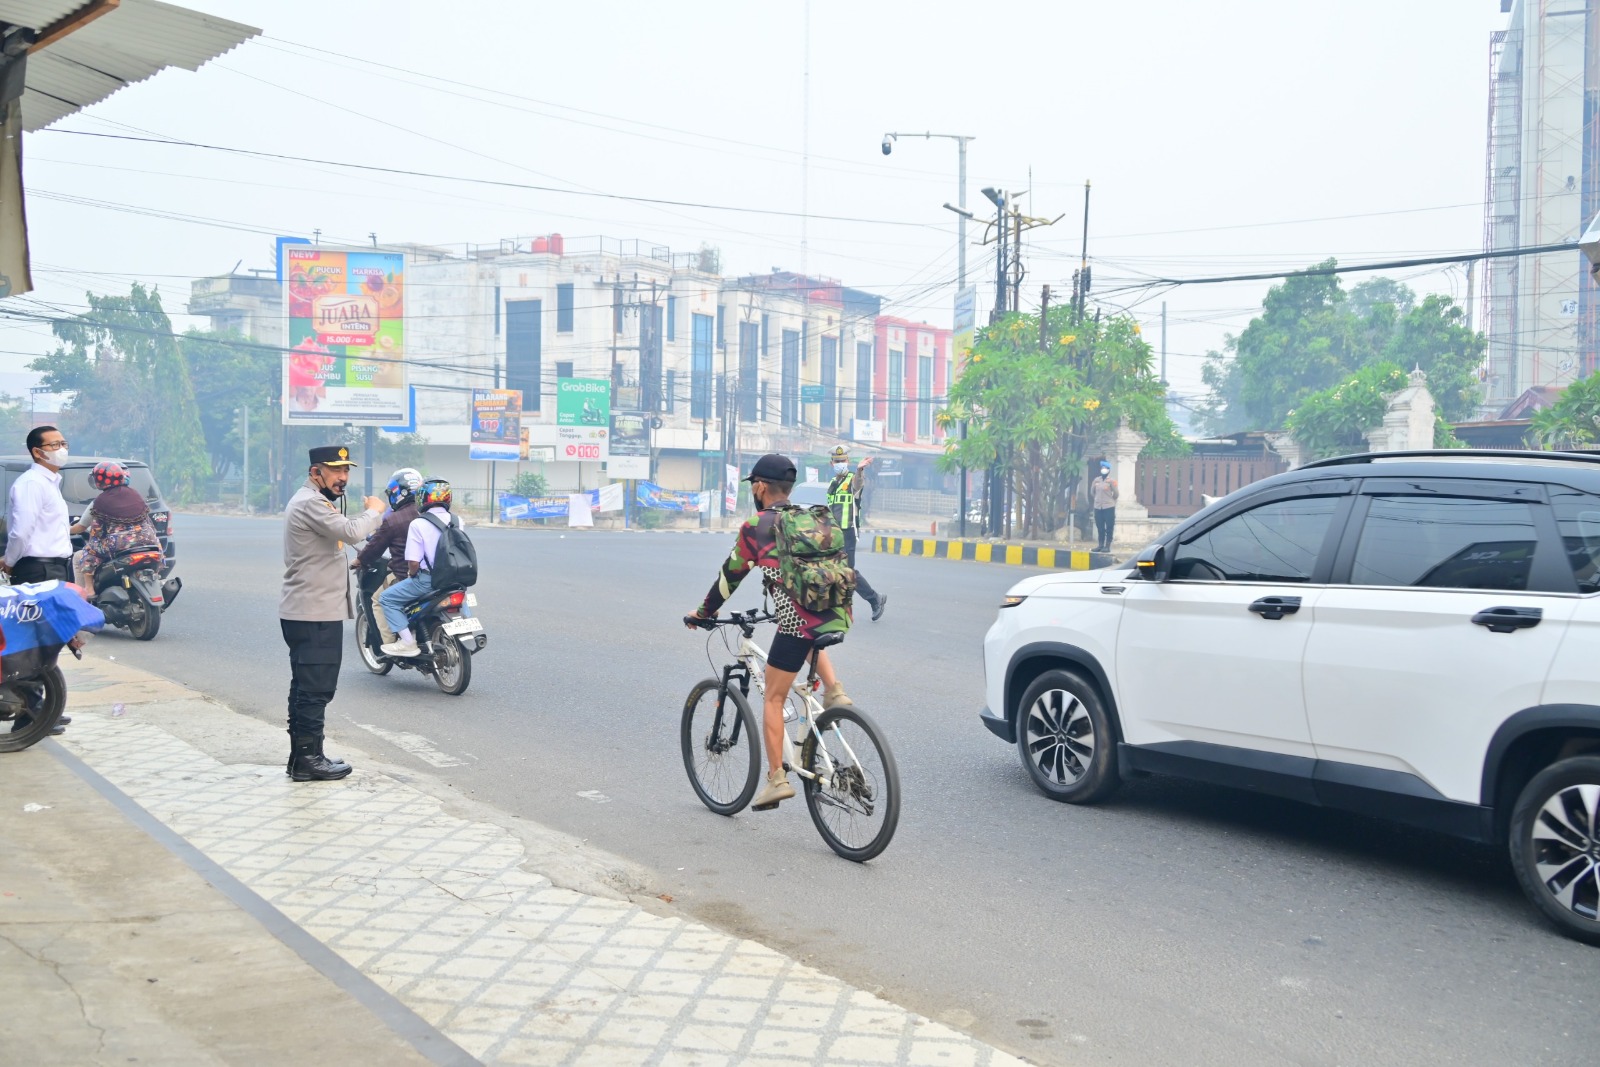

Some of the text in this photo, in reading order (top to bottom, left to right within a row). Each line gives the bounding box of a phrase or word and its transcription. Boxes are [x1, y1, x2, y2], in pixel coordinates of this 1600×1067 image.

[290, 250, 315, 258] NEW
[316, 266, 342, 274] PUCUK
[352, 268, 384, 276] MARKISA
[319, 303, 372, 326] JUARA
[351, 365, 378, 373] PISANG
[561, 382, 606, 393] GrabBike
[480, 420, 498, 430] 110
[579, 446, 599, 457] 110
